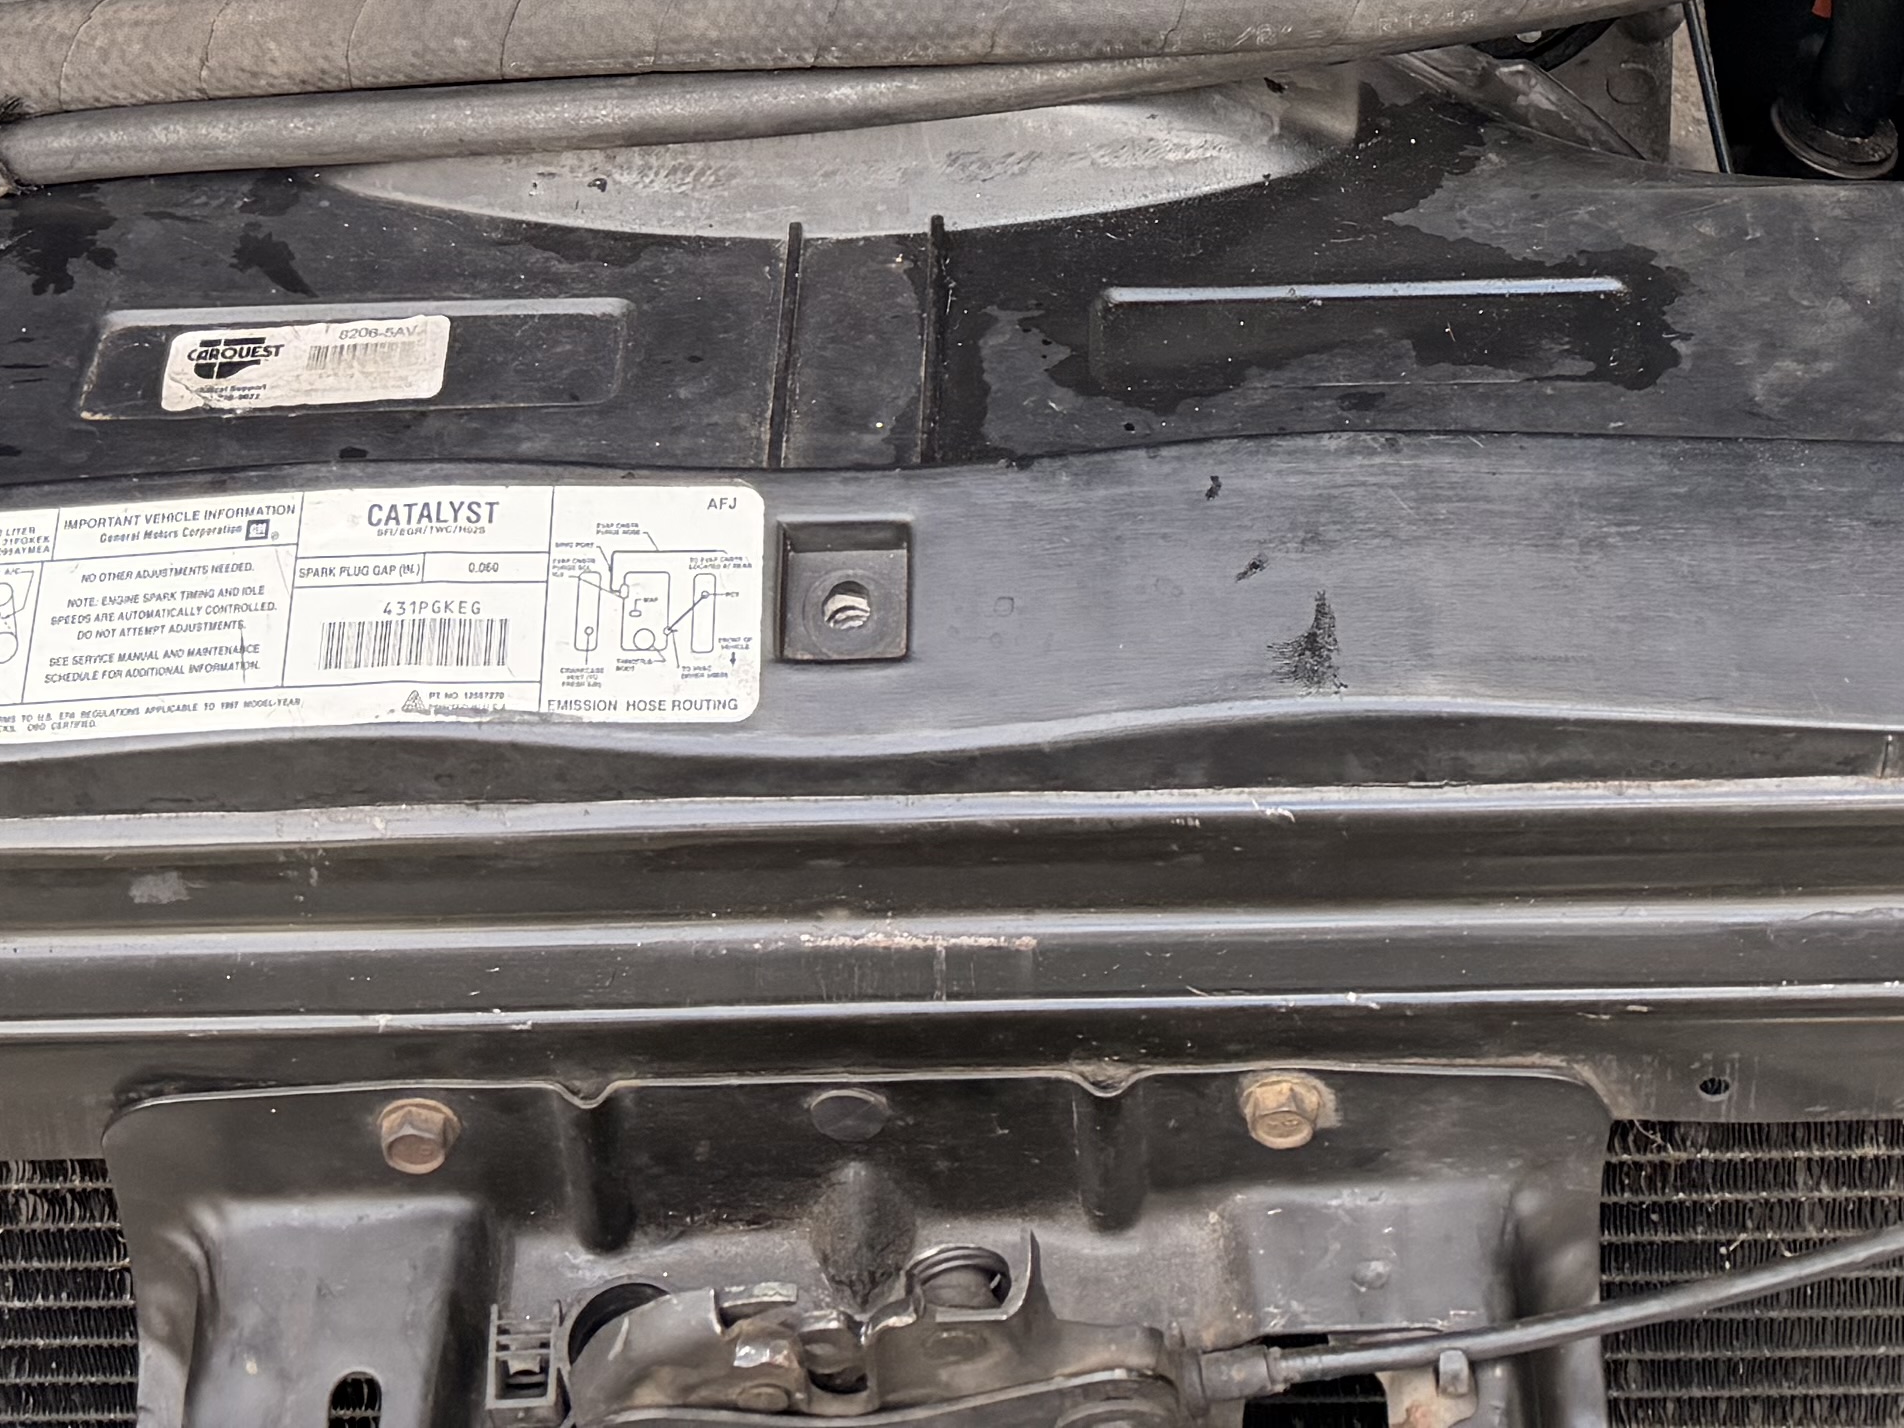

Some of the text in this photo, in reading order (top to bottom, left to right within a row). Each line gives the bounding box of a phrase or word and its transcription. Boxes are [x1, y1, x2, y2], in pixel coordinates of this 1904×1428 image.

[187, 344, 284, 360] CARQUEST
[367, 501, 500, 527] CATALYST
[707, 498, 737, 510] AFJ
[63, 504, 296, 530] IMPORTANT VEHICLE INFORMATION
[99, 524, 242, 543] General Motors Corporation
[81, 562, 254, 583] NO OTHER ADJUSTMENTS NEEDED.
[299, 566, 336, 577] SPARK
[340, 566, 369, 576] PLUG
[373, 565, 396, 576] GAP
[468, 562, 499, 573] 0.060
[67, 585, 264, 609] NOTE: ENGINE SPARK TIMING AND IDLE
[51, 602, 277, 626] SPEEDS ARE AUTOMATICALLY CONTROLLED.
[383, 600, 481, 615] 431PGKEG
[77, 620, 246, 640] DO NOT ATTEMPT ADJUSTMENTS.
[49, 644, 260, 667] SEE SERVICE MANUAL AND MAINTENANCE
[44, 659, 261, 684] SCHEDULE FOR ADDITIONAL INFORMATION.
[548, 698, 738, 712] EMISSION HOSE ROUTING
